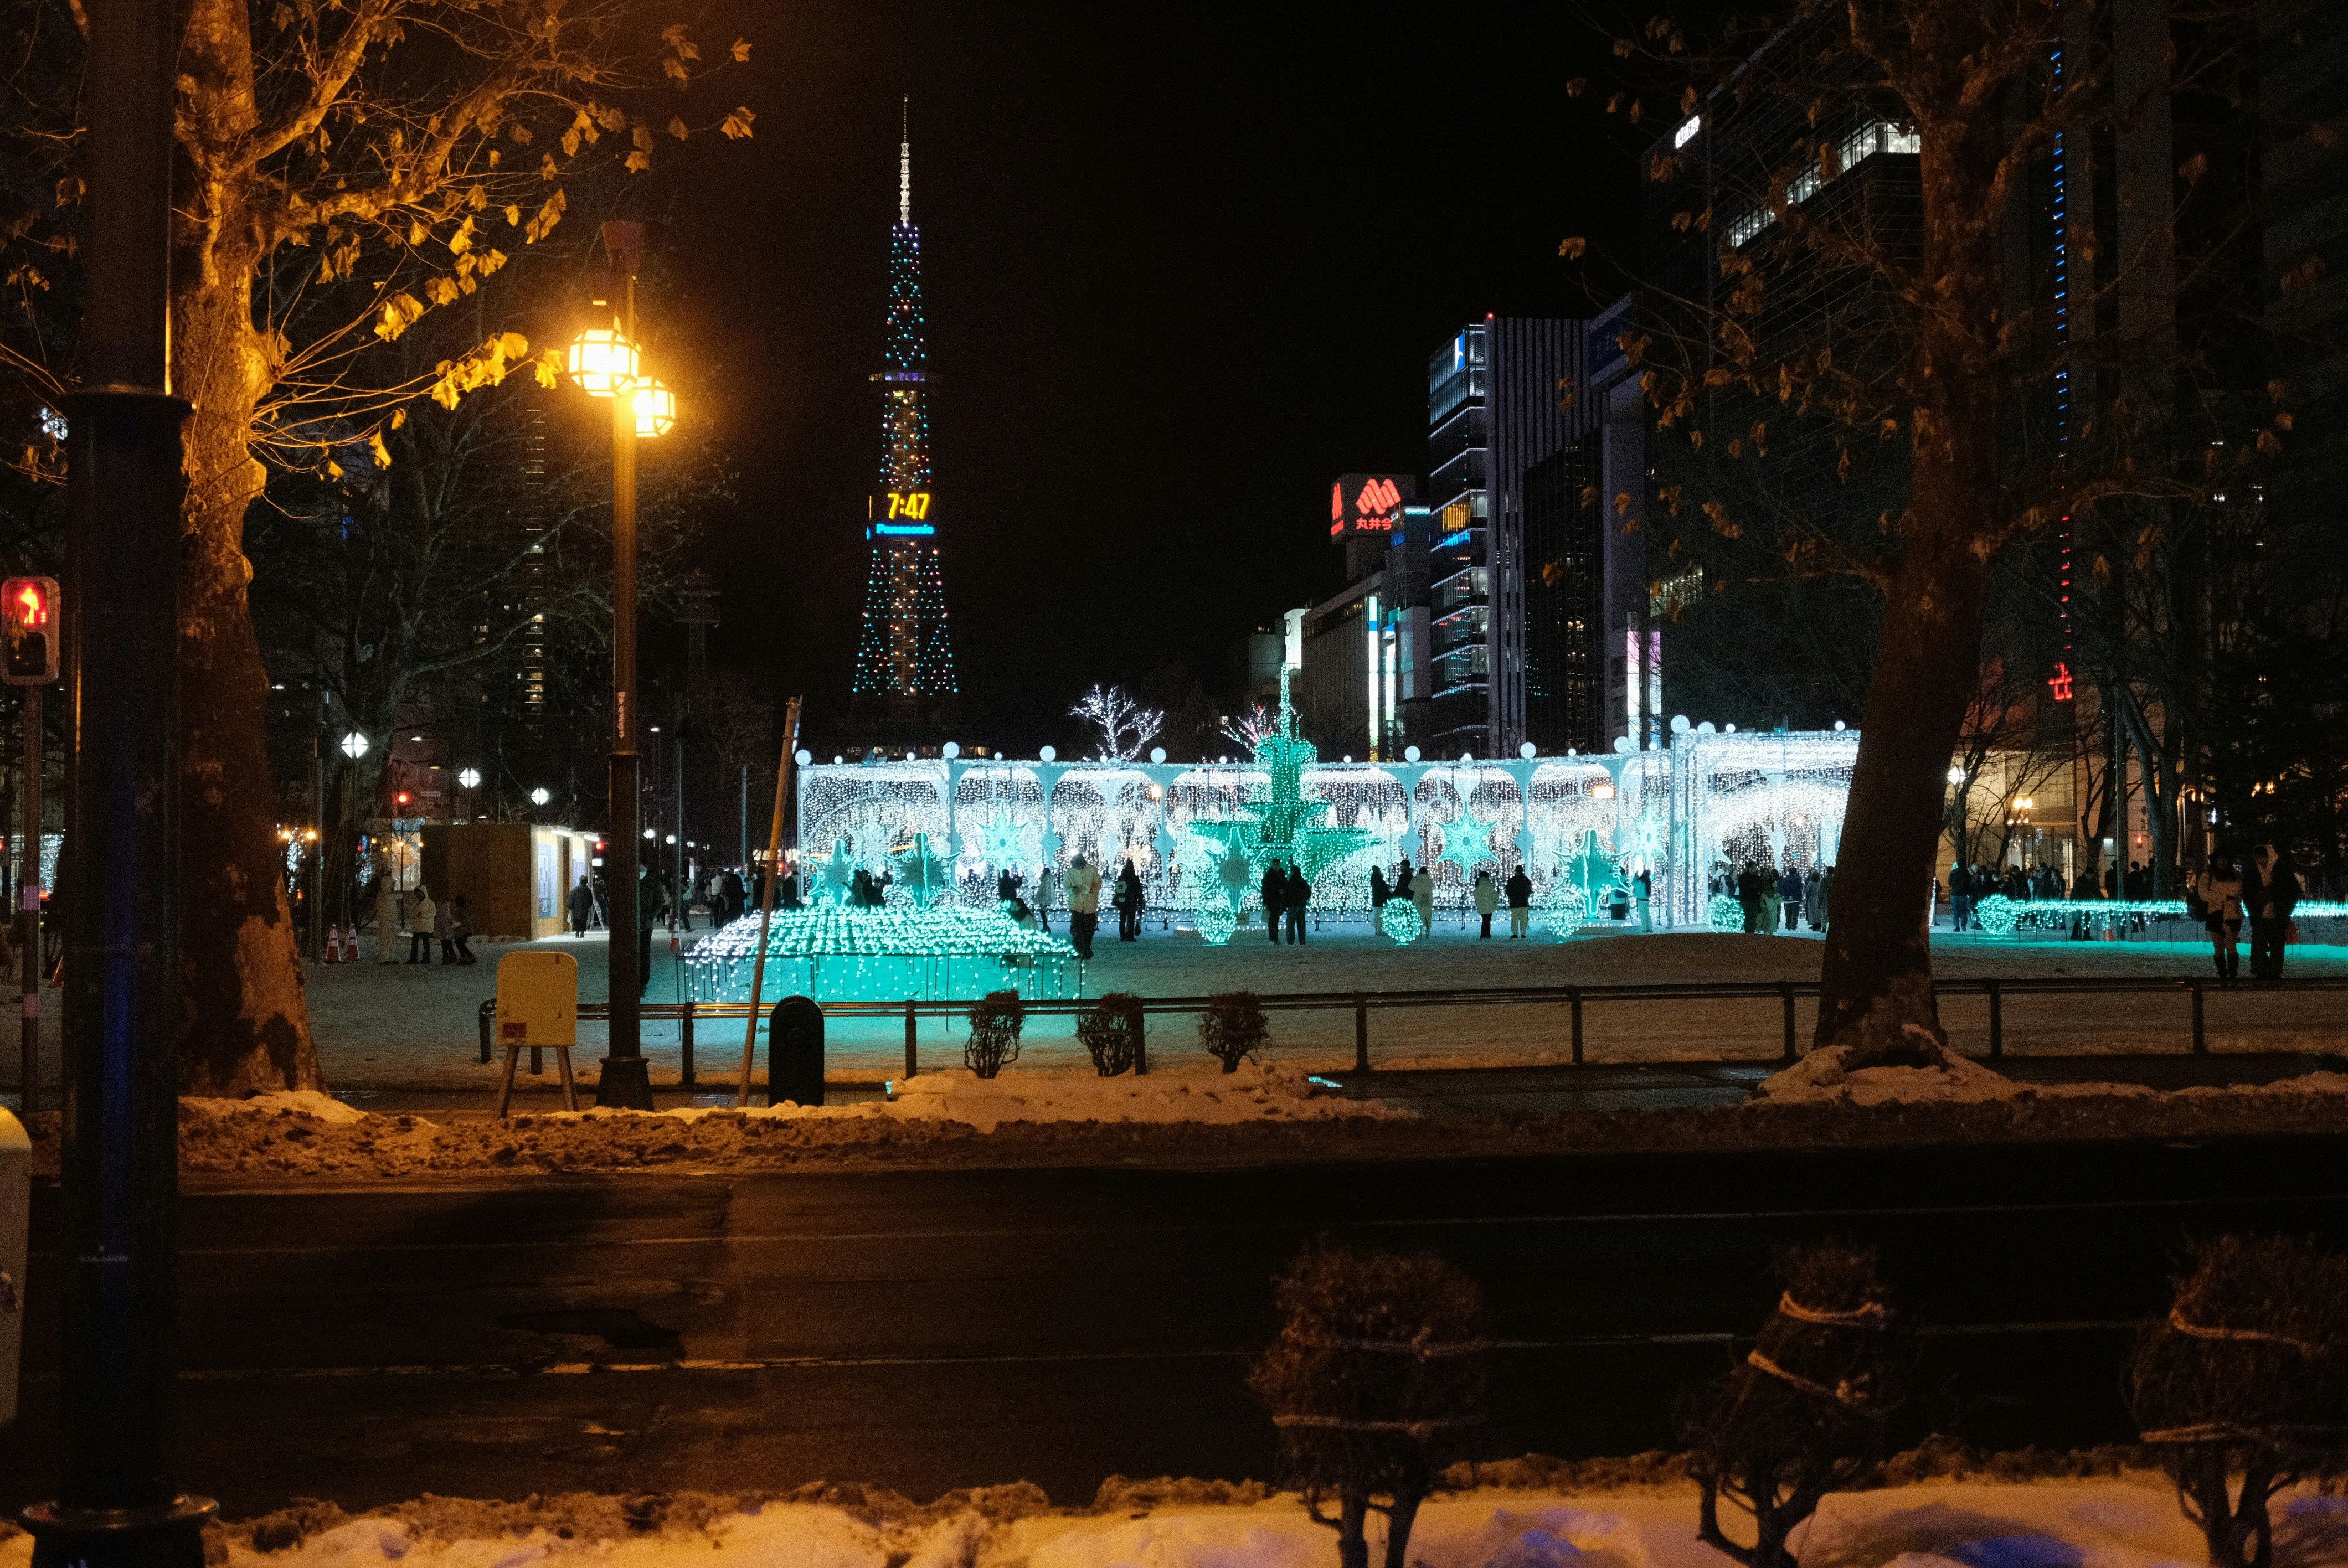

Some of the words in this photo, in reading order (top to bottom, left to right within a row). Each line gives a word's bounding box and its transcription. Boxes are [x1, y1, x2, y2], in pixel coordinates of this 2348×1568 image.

[887, 493, 930, 519] 7:47
[876, 523, 935, 534] Panasonic
[1356, 517, 1392, 530] 丸井今
